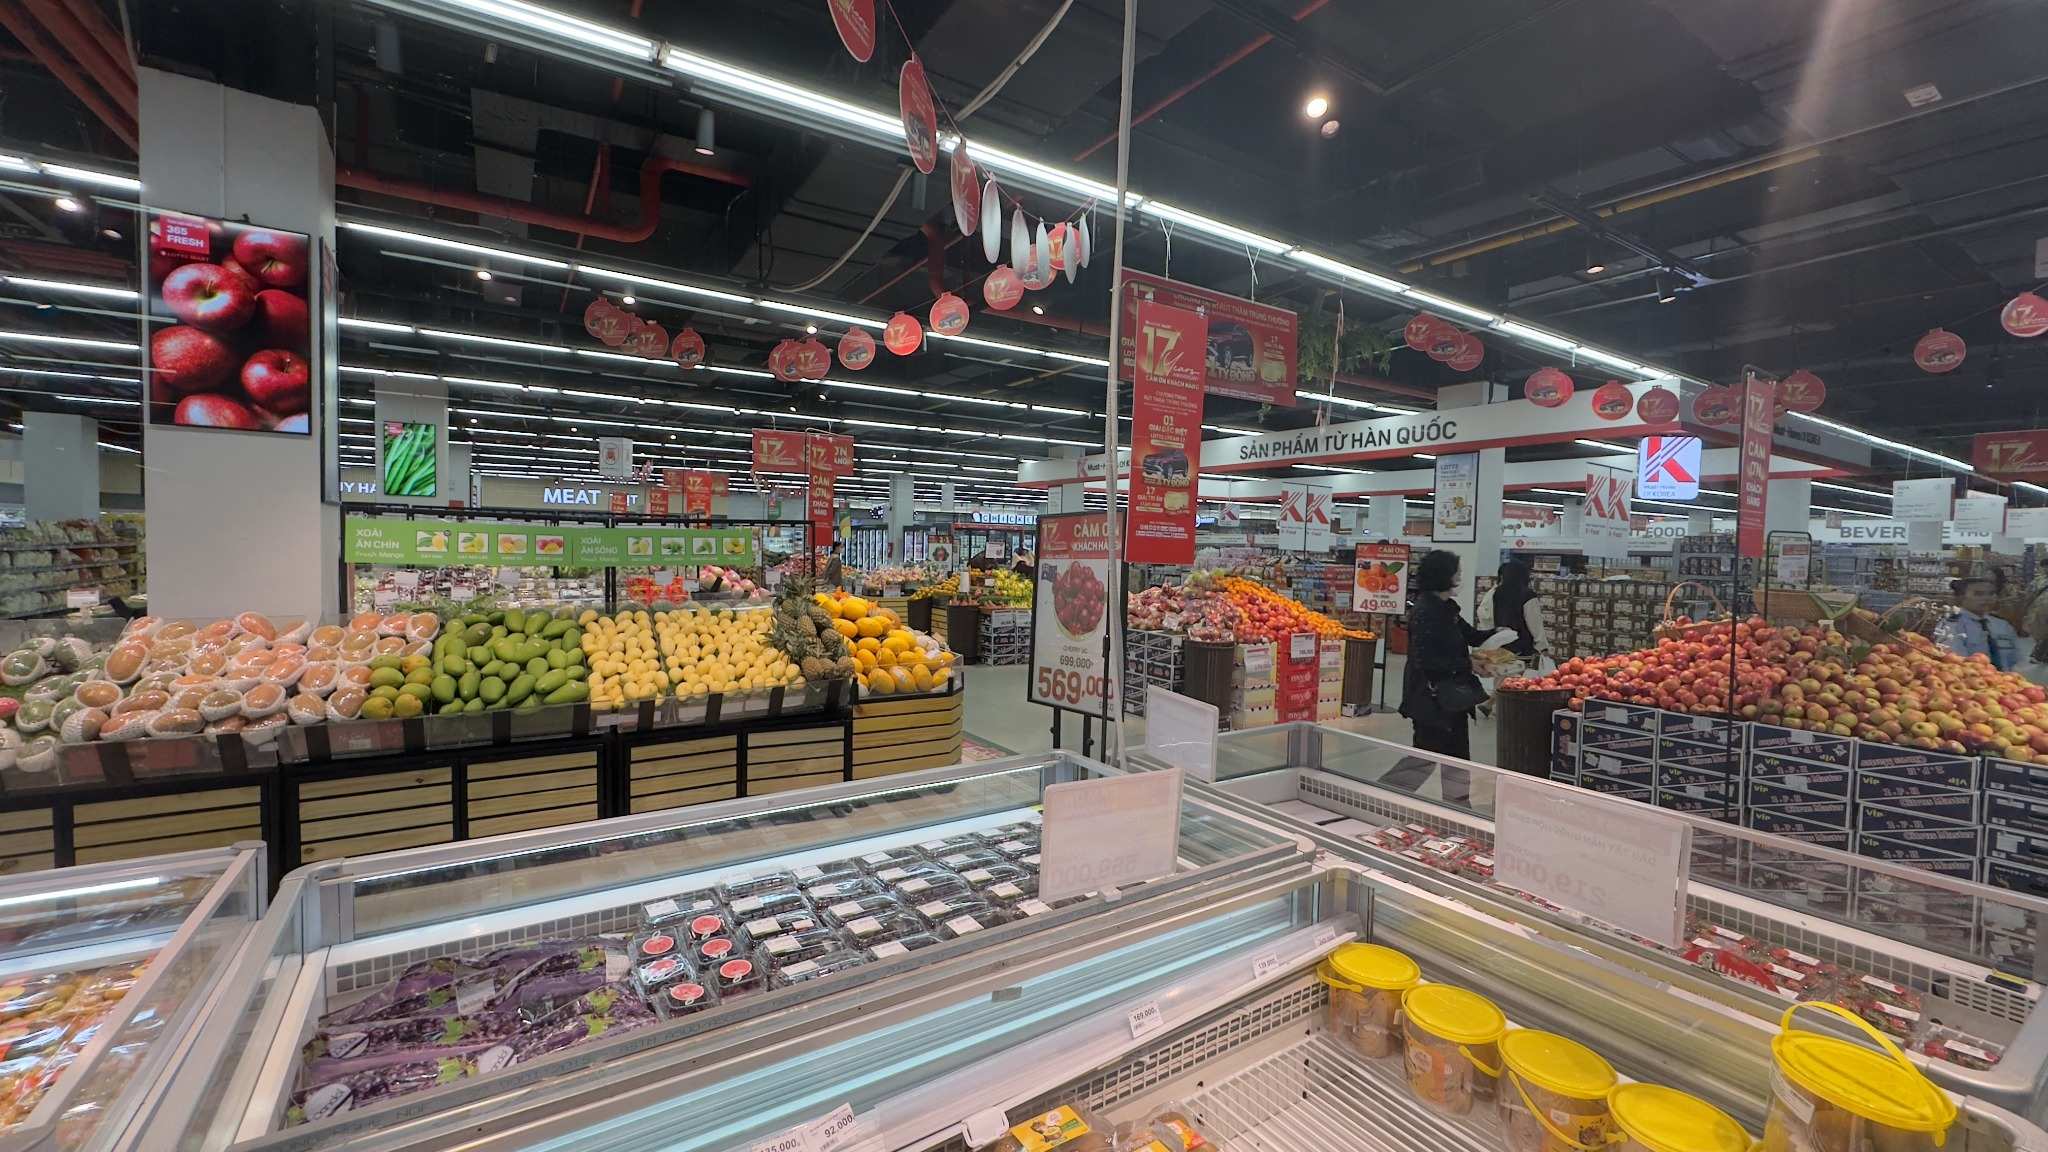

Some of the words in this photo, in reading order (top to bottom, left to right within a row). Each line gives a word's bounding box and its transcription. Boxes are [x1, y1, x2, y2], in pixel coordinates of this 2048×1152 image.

[166, 225, 188, 236] 365
[166, 235, 205, 248] FRESH
[1142, 325, 1182, 376] 17
[1163, 415, 1174, 426] 01
[1239, 441, 1270, 461] SẢN
[1272, 432, 1319, 457] PHẨM
[1324, 432, 1348, 451] TỪ
[1351, 426, 1391, 450] HÀN
[1396, 415, 1458, 445] QUỐC
[1985, 442, 2033, 472] 17
[543, 487, 602, 505] MEAT
[982, 513, 1038, 524] CHICKE
[356, 526, 383, 538] XOÀI
[1073, 518, 1101, 538] CẢM
[375, 538, 400, 550] CHÍN
[1072, 538, 1099, 552] KHÁCH
